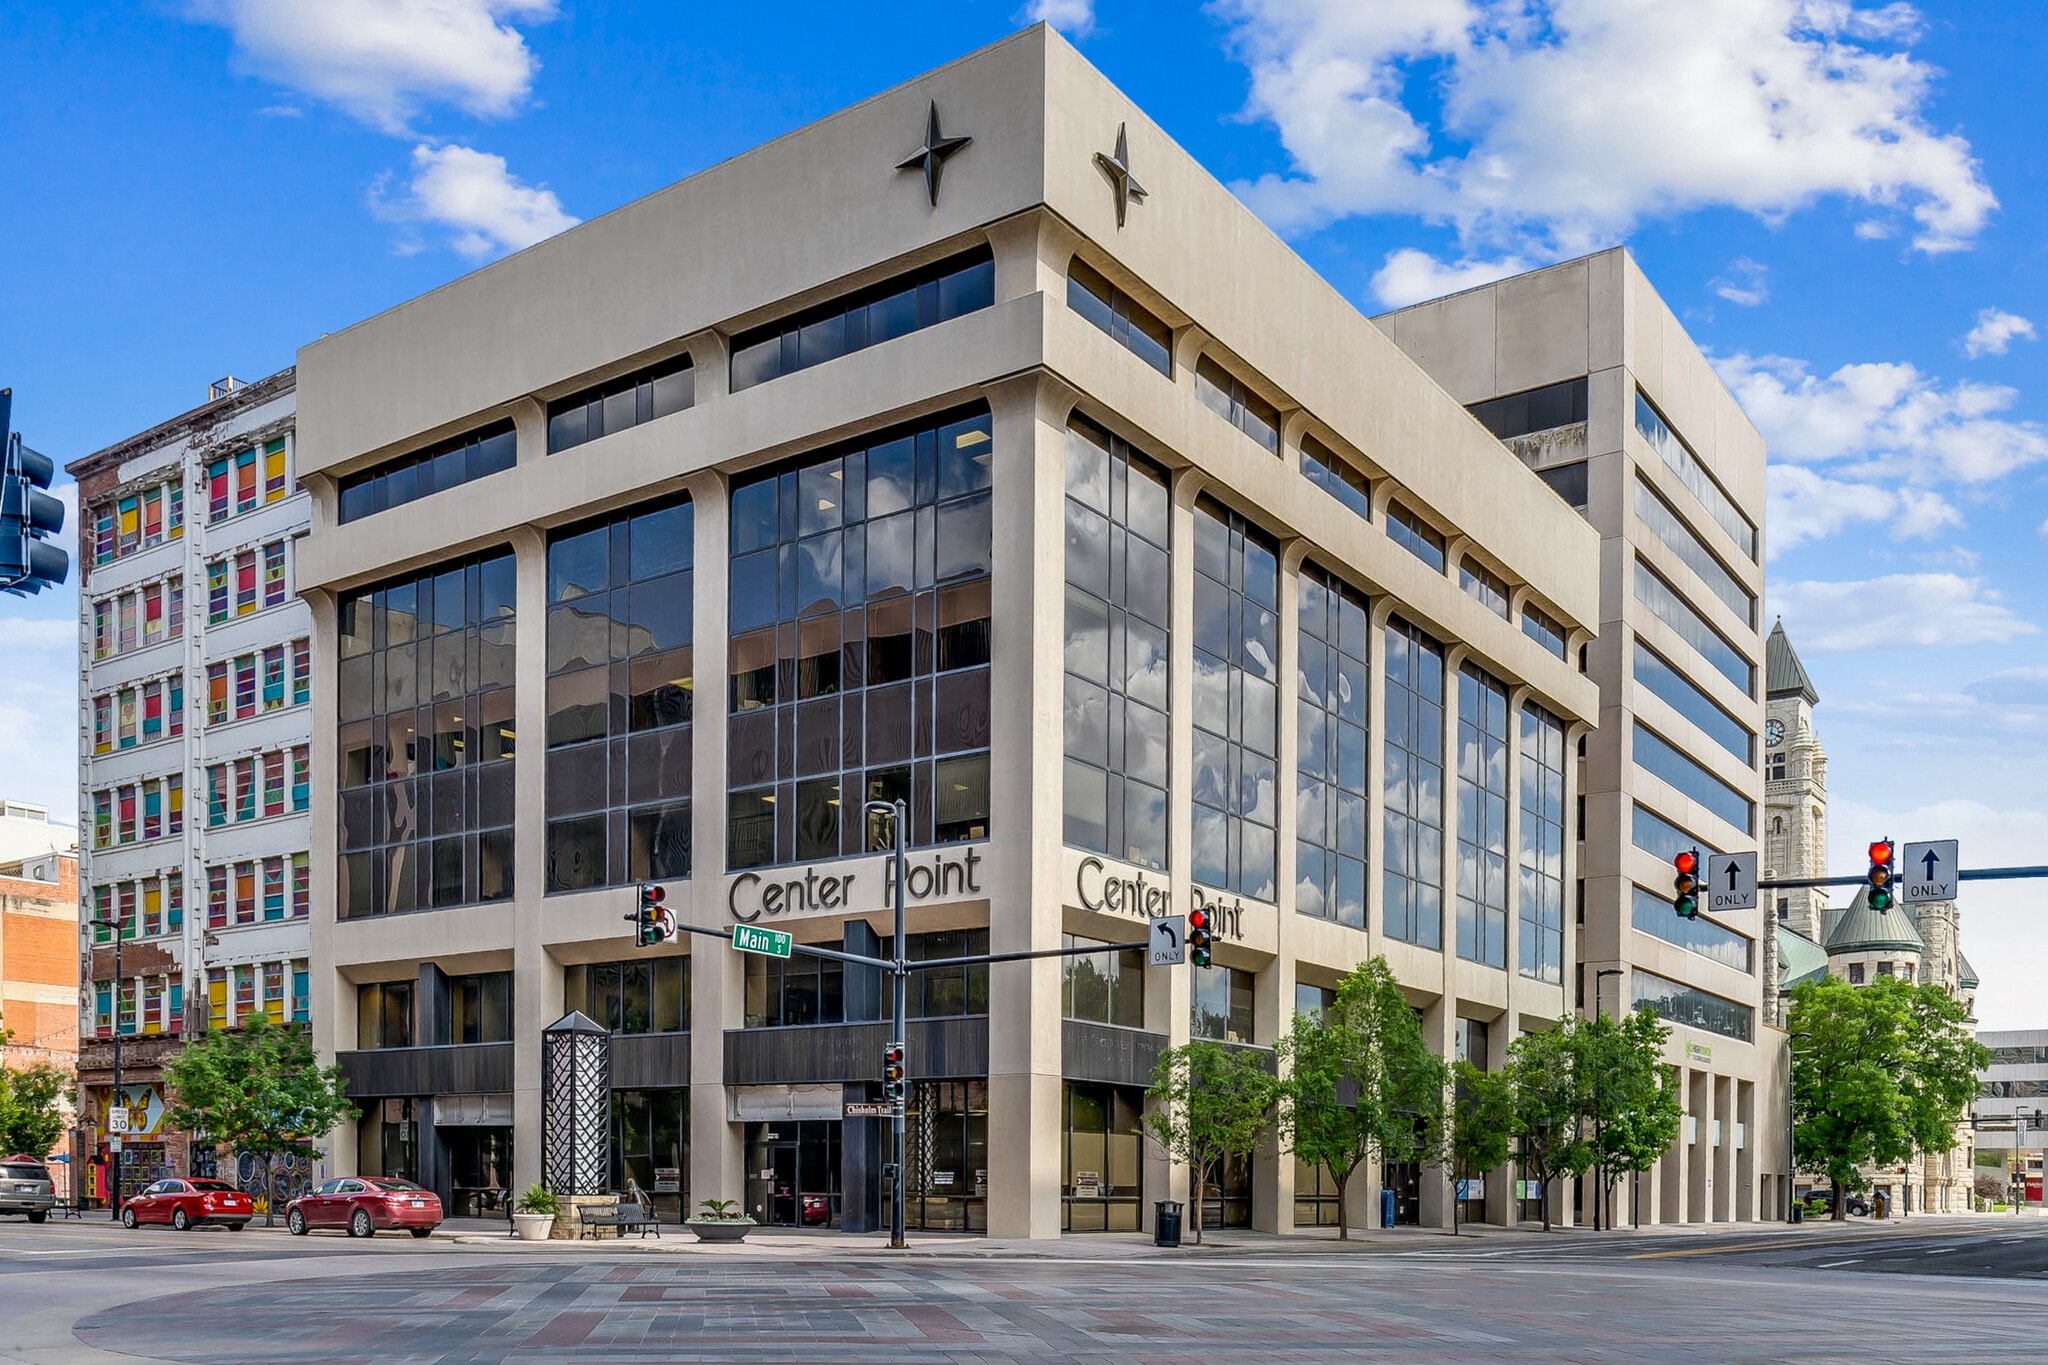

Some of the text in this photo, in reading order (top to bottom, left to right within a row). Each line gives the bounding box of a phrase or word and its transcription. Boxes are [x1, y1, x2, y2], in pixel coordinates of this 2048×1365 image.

[729, 847, 981, 922] Center Point
[1077, 856, 1171, 918] Center
[1911, 883, 1949, 897] ONLY
[1715, 893, 1749, 906] ONLY
[739, 928, 769, 951] Main
[775, 933, 786, 944] 100
[776, 944, 782, 954] S
[1154, 950, 1181, 962] ONLY
[876, 1105, 892, 1114] Trail
[112, 1120, 127, 1130] 30
